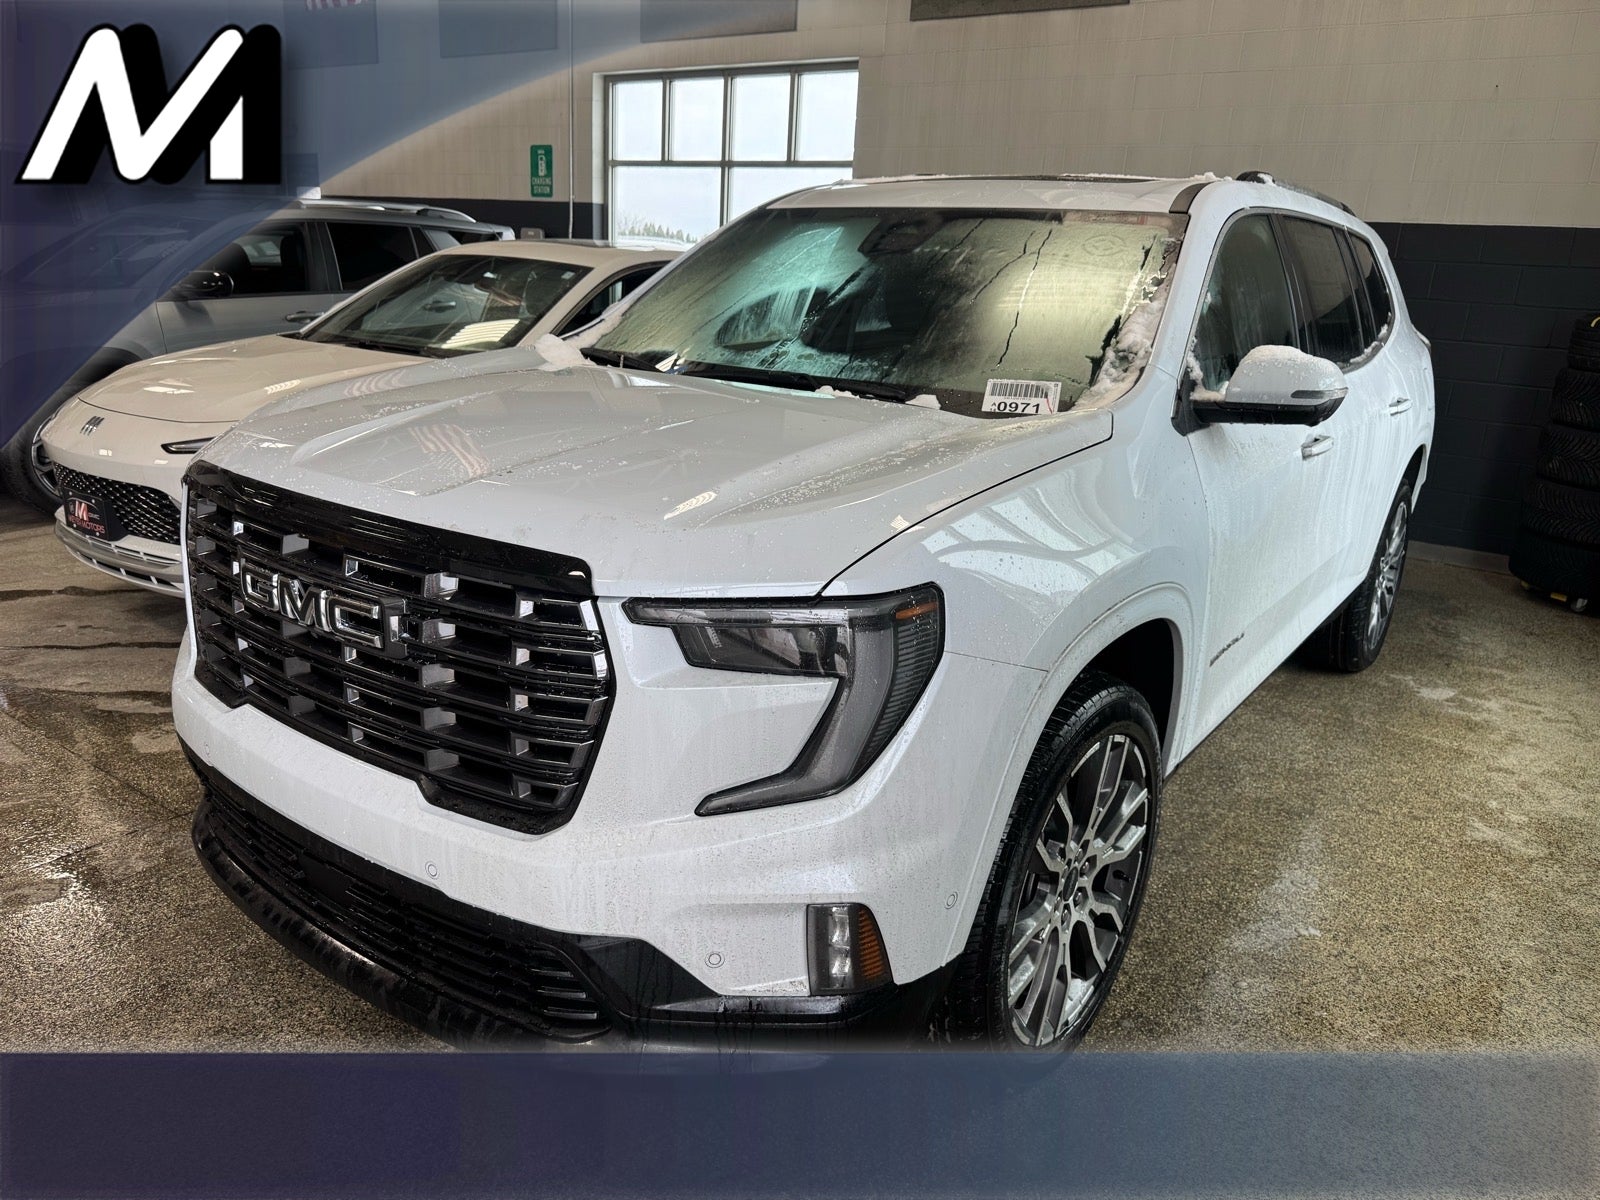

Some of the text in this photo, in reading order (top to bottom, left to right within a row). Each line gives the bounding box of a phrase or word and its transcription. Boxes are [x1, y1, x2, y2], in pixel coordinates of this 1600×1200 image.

[997, 401, 1041, 414] 0971
[82, 520, 106, 534] MOTORS
[241, 563, 383, 649] GMC
